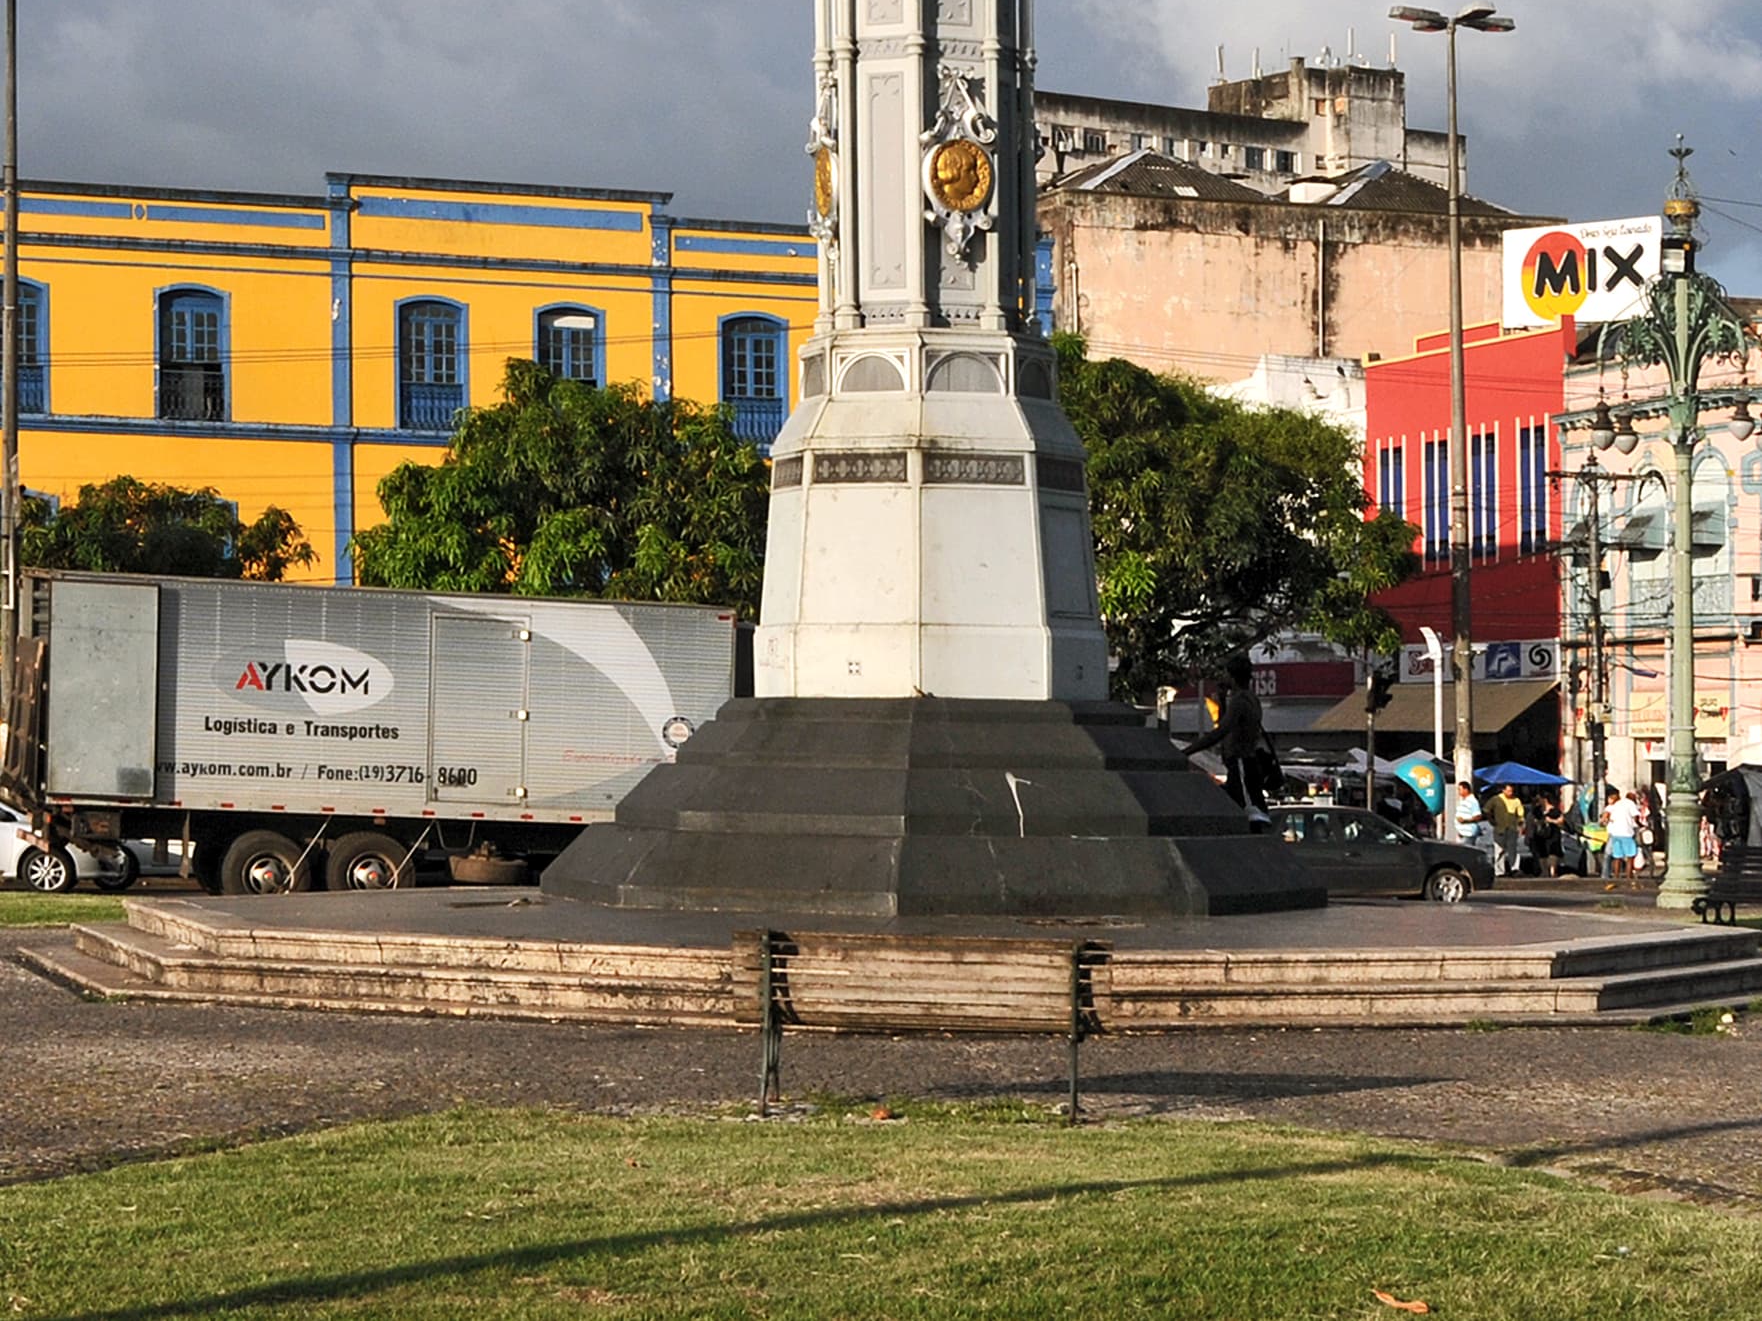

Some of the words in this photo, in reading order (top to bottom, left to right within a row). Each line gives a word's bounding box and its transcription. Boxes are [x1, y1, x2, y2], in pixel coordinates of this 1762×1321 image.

[1533, 243, 1644, 297] MIX
[235, 661, 369, 695] AYKOM
[286, 723, 295, 735] e
[304, 720, 399, 741] Transportes
